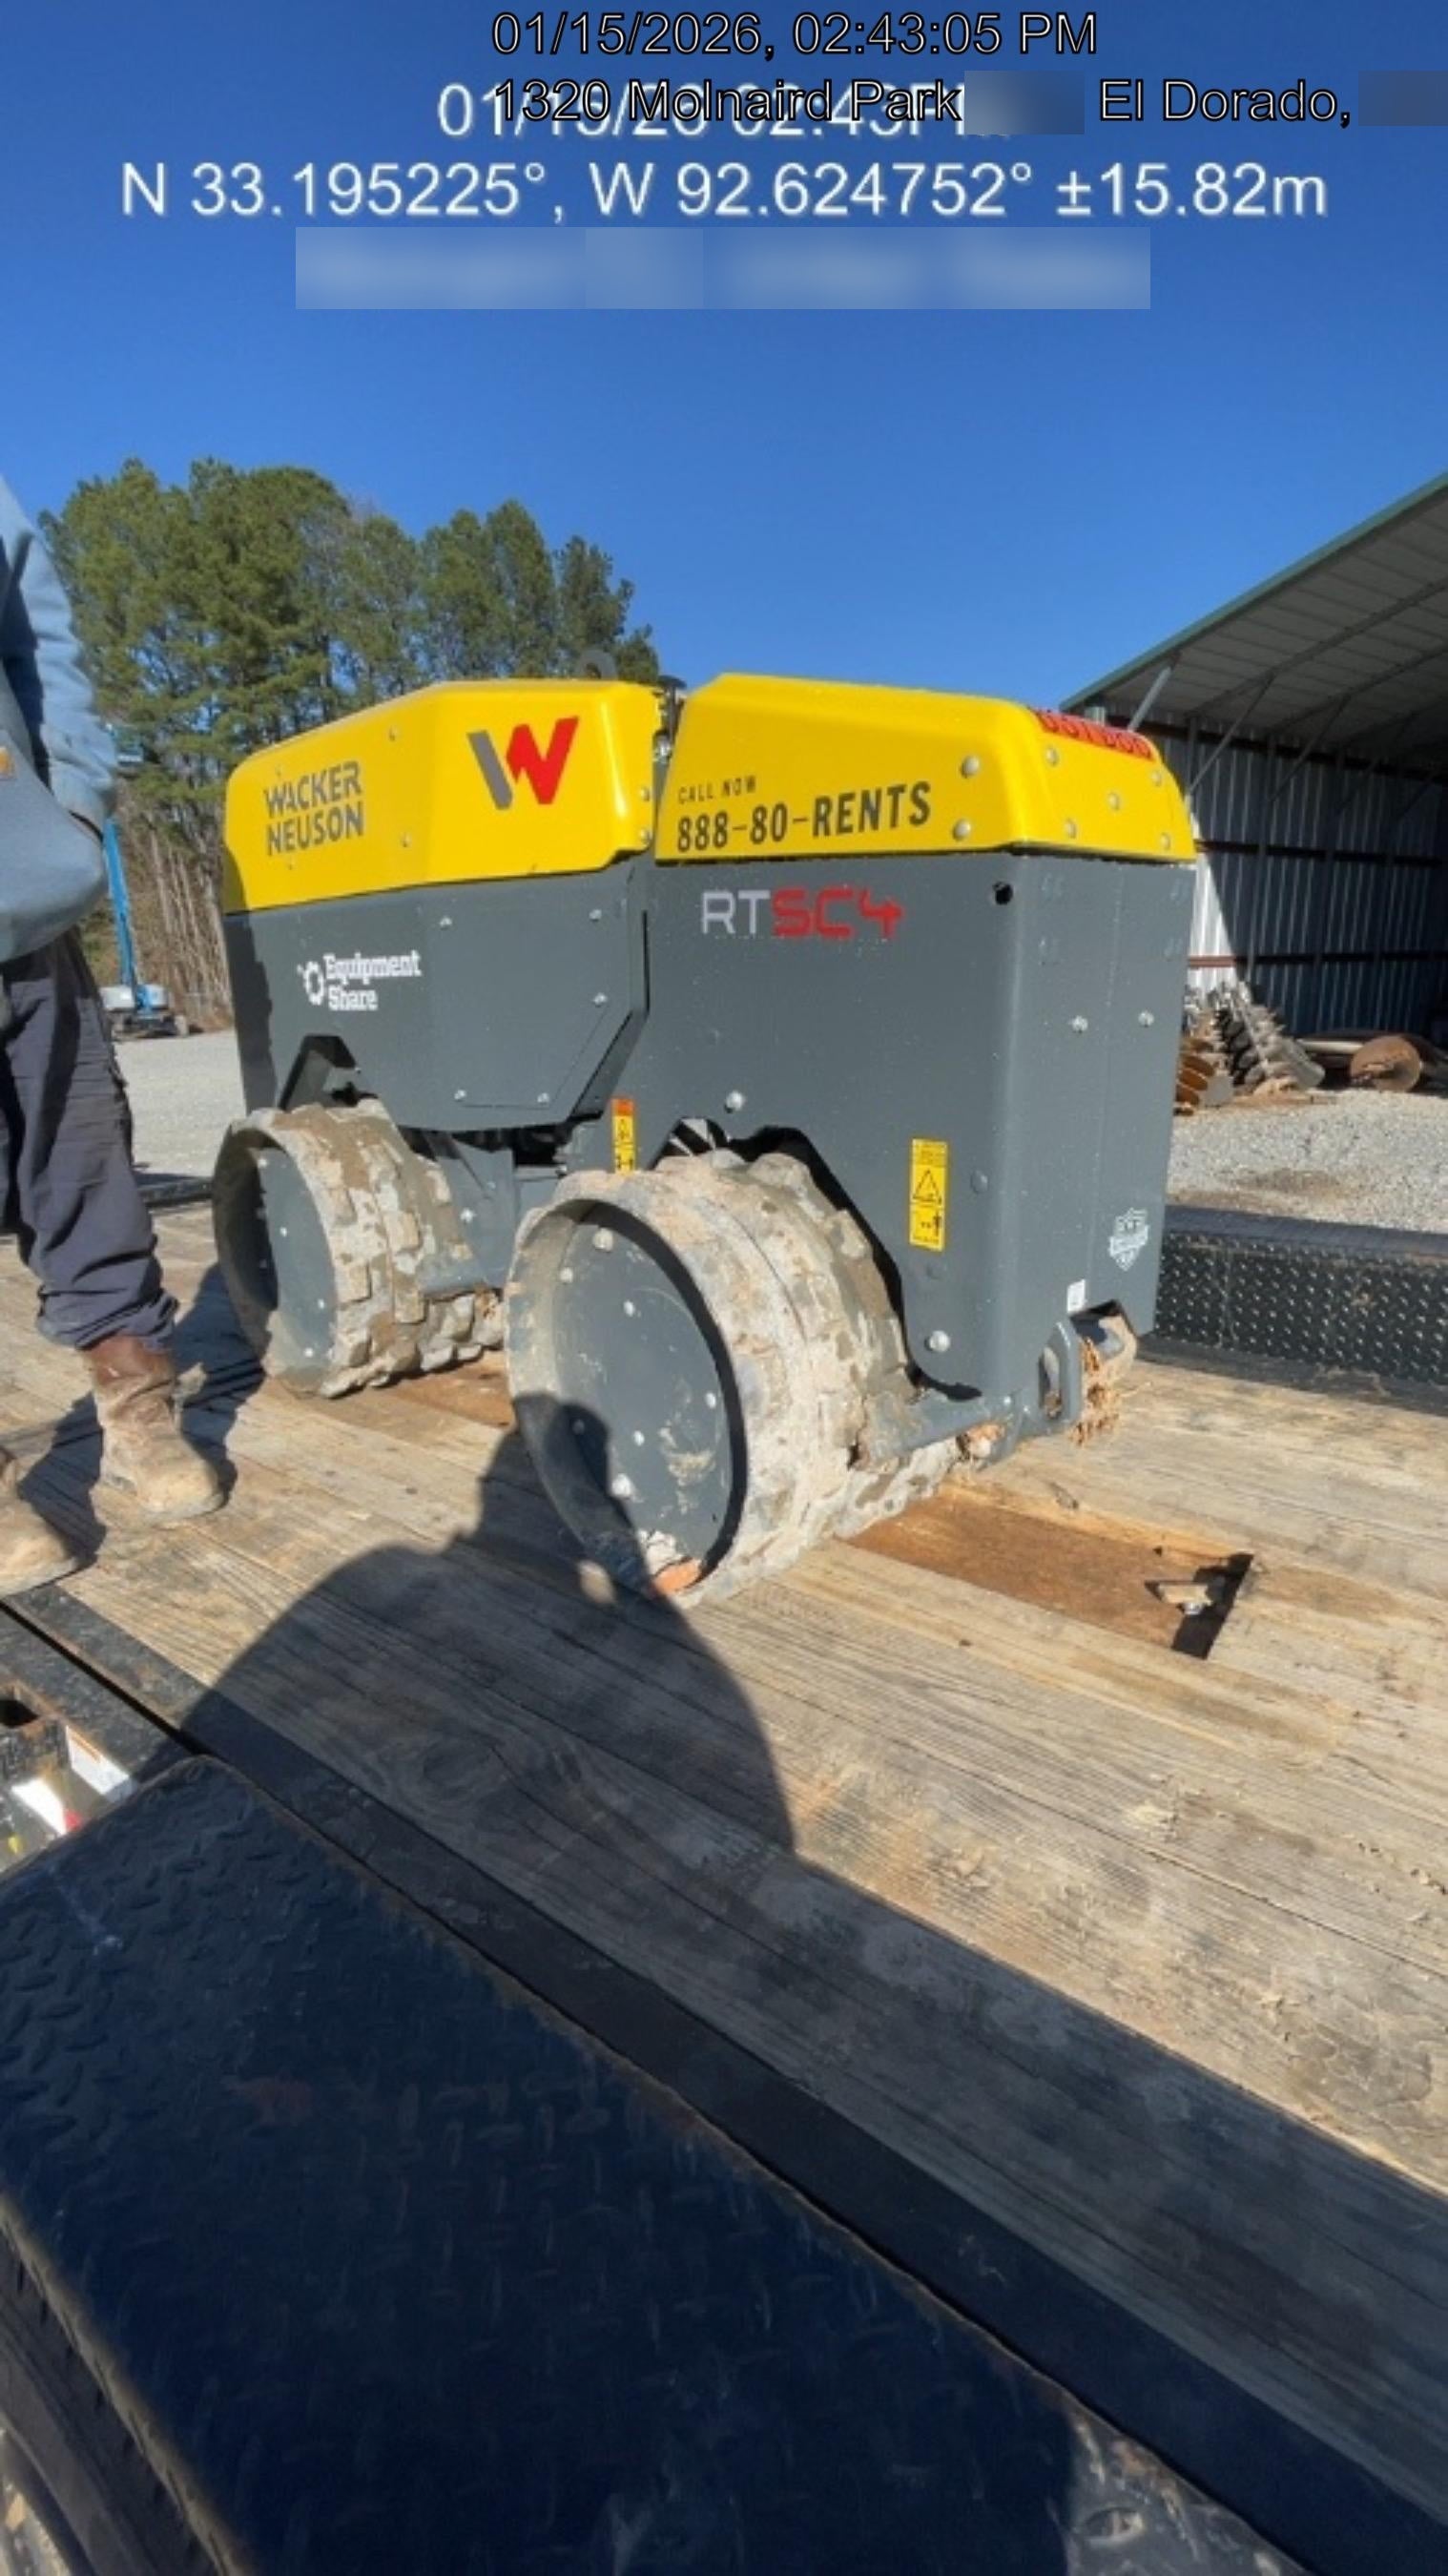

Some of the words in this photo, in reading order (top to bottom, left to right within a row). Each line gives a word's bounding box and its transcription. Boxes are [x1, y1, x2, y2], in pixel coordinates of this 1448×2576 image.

[263, 760, 362, 819] WACKER
[676, 779, 932, 852] 888-80-RENTS
[678, 786, 714, 804] CALL
[722, 776, 756, 796] NOW
[266, 800, 364, 856] NEUSON
[701, 884, 903, 939] RTSC4
[322, 950, 423, 985] Equipment
[327, 984, 379, 1011] Share
